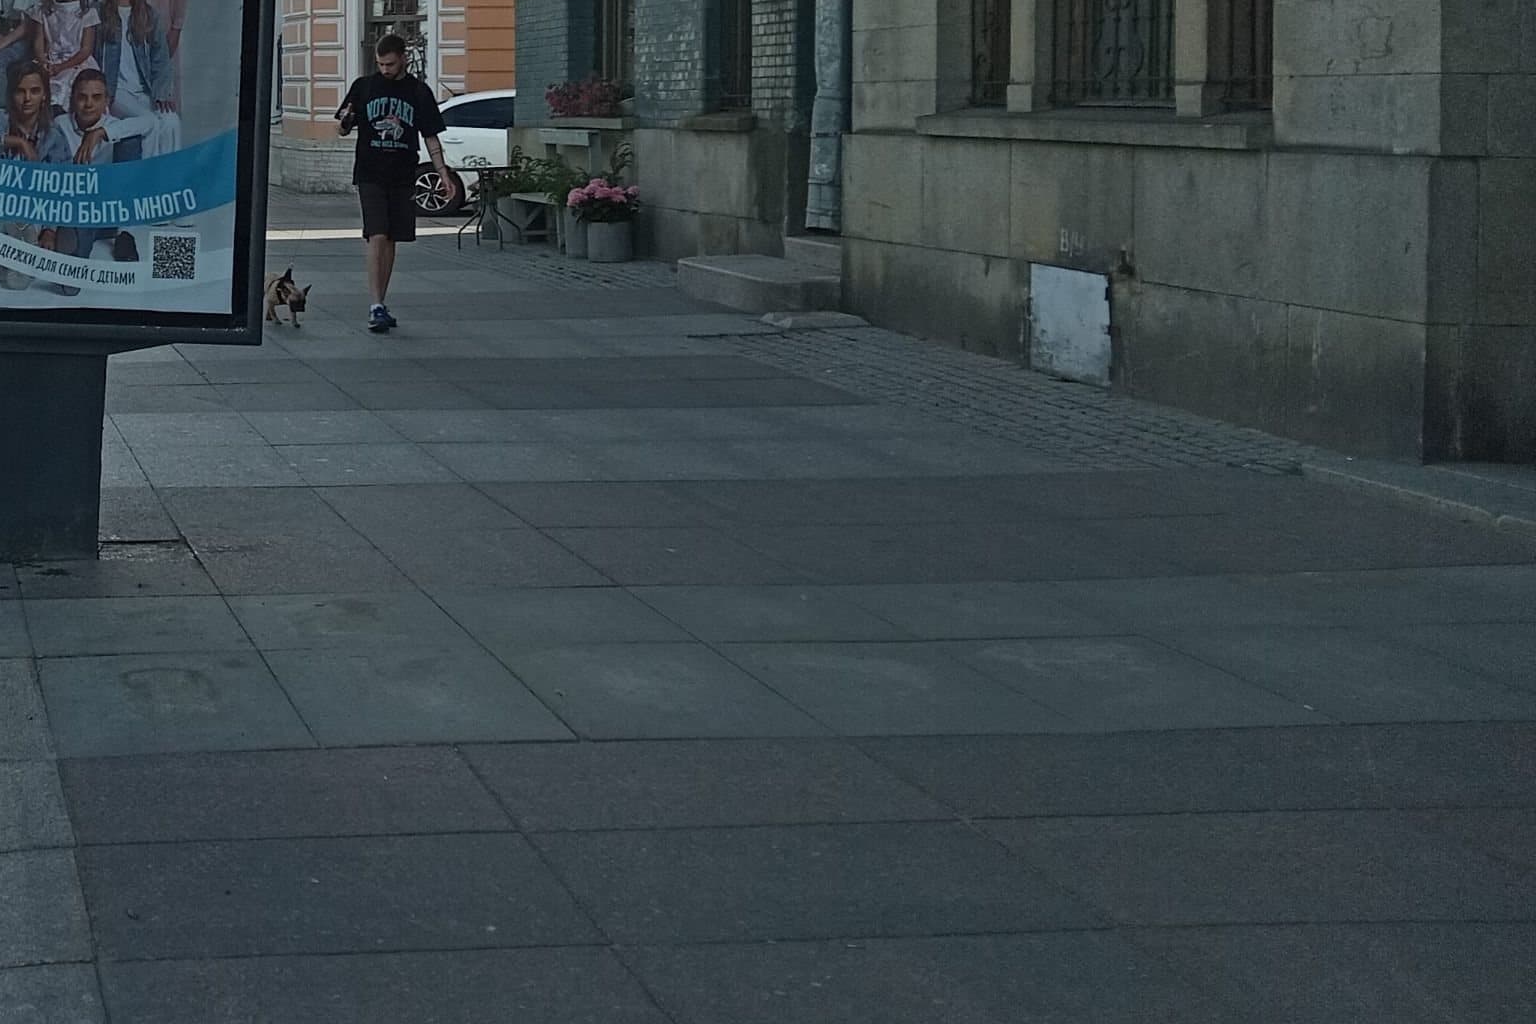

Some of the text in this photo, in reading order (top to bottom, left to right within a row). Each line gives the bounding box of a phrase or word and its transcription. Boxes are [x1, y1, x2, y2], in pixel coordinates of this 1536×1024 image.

[366, 97, 388, 122] NOT
[28, 168, 99, 195] ЛЮДЕЙ
[78, 201, 130, 224] БЫТЬ
[133, 188, 197, 222] МНОГО
[36, 257, 58, 273] ДЛЯ
[58, 264, 88, 281] СЕМЕЙ
[90, 269, 96, 282] С
[96, 270, 136, 285] ДЕТЬМИ
